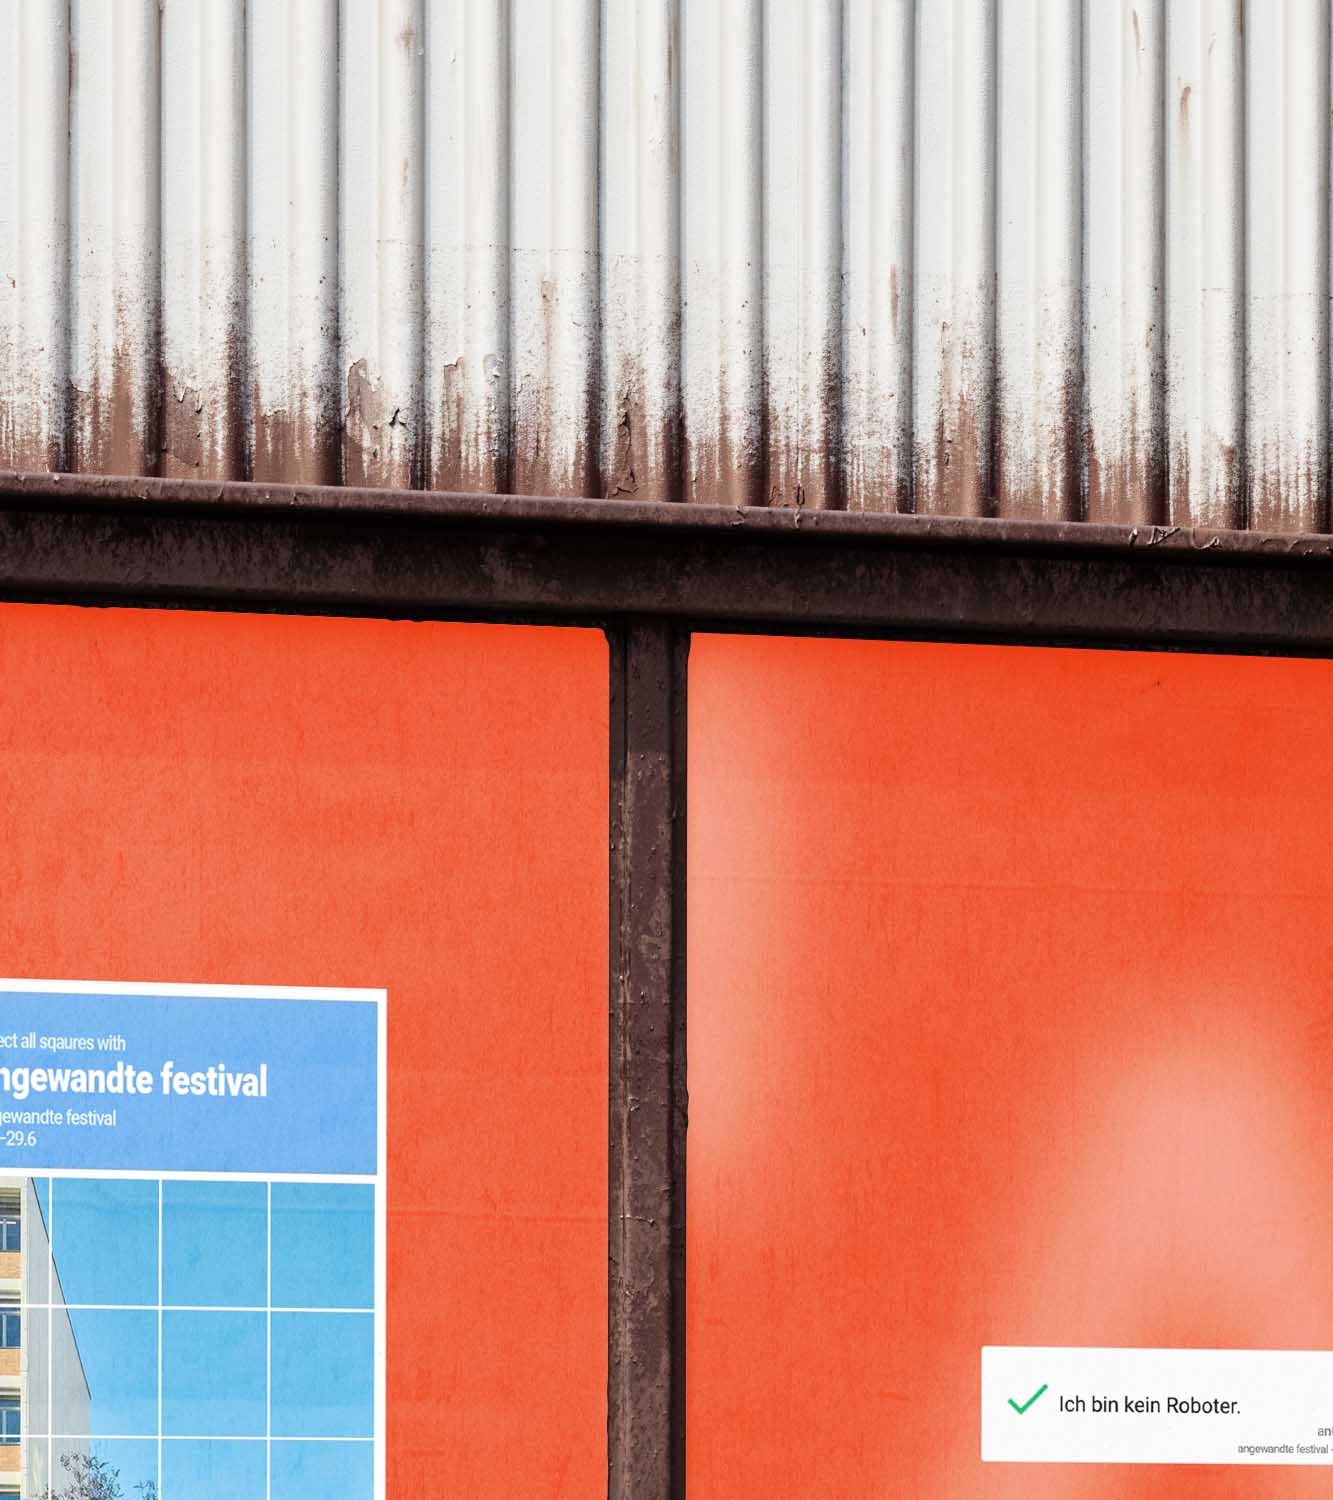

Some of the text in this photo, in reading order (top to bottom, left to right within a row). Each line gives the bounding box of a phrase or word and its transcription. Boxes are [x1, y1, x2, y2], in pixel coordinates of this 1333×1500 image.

[20, 1032, 37, 1049] all
[39, 1037, 95, 1053] sqaures
[96, 1035, 127, 1051] with
[159, 1061, 268, 1097] festival
[0, 1109, 117, 1127] ewandte festival
[1059, 1396, 1241, 1415] Ich bin kein Roboter.
[1237, 1445, 1295, 1456] angewandte
[1295, 1444, 1329, 1455] festival
